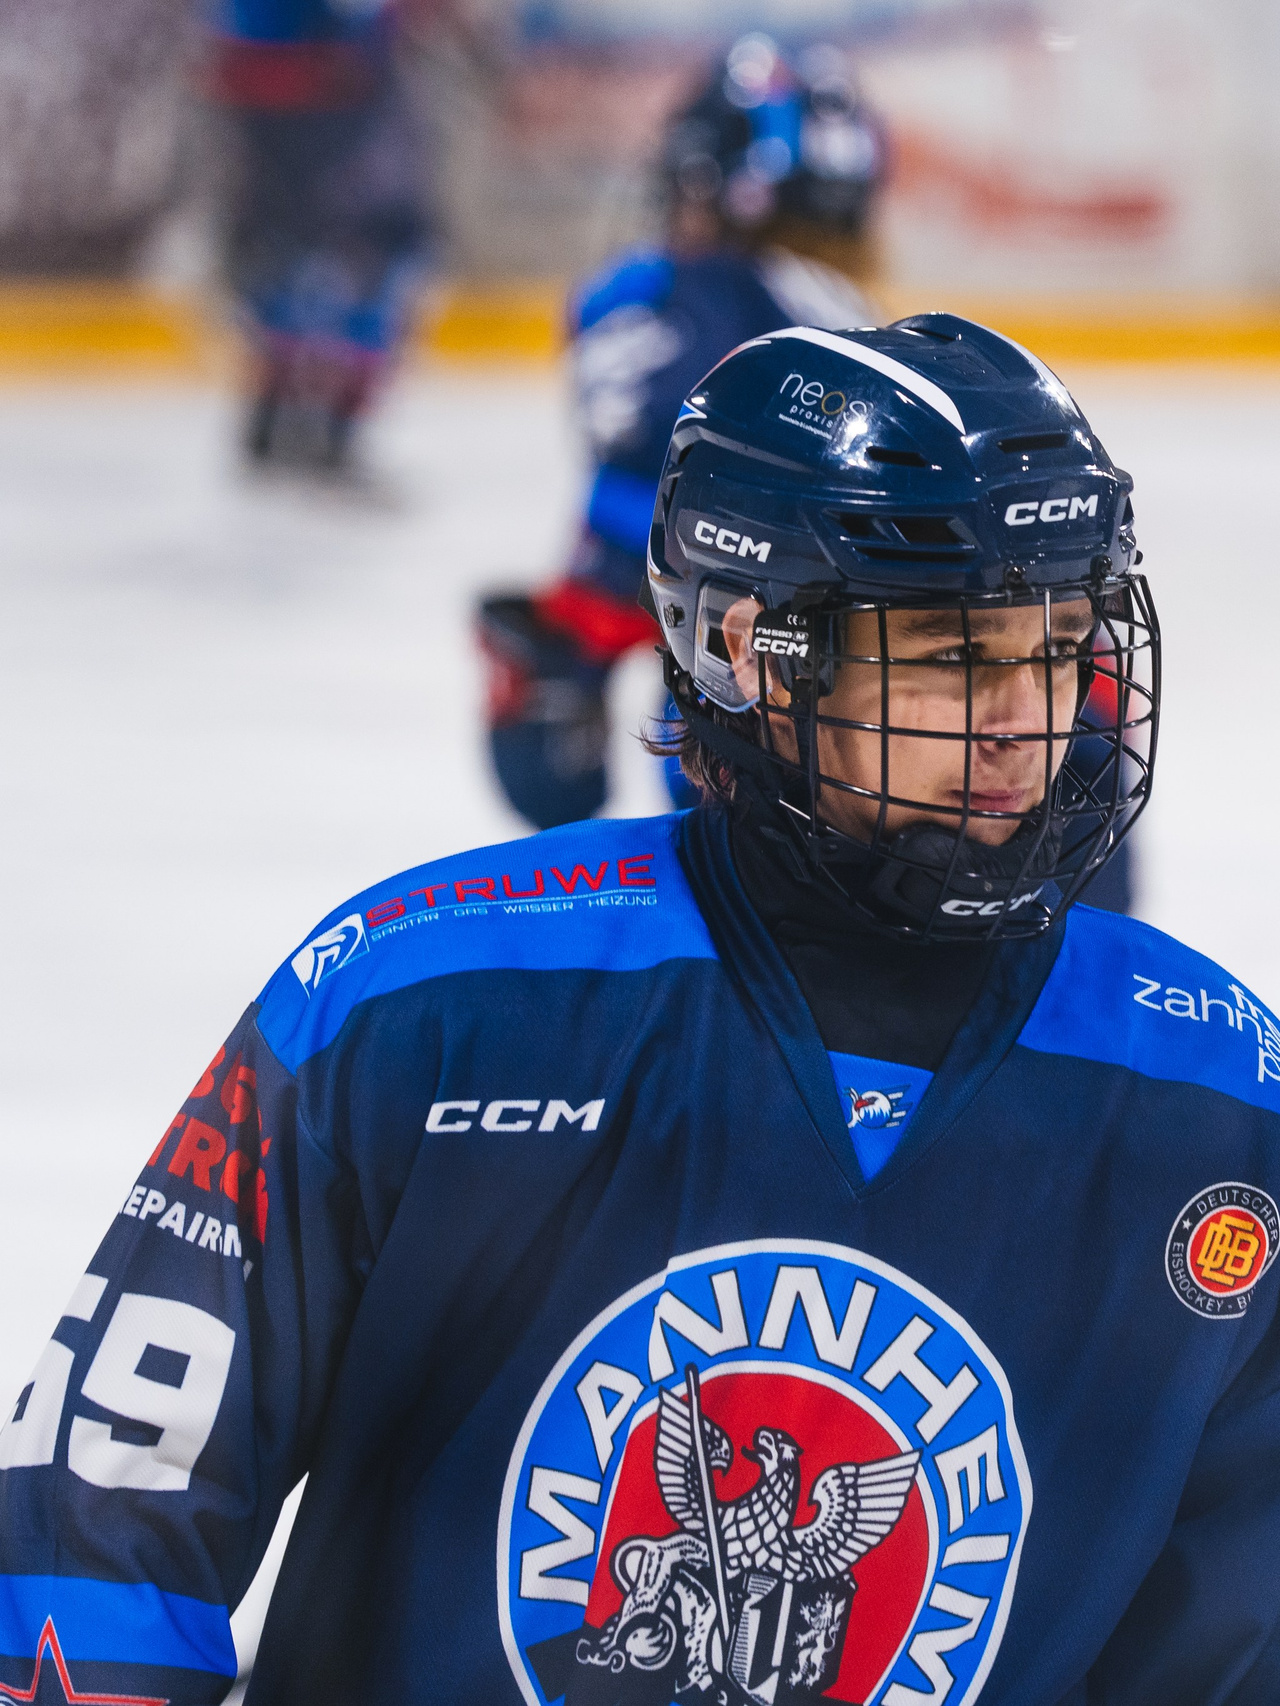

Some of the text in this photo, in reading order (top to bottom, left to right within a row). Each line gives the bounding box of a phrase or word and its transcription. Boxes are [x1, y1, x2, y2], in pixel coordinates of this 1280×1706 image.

[789, 404, 834, 429] praxis
[1004, 494, 1098, 526] CCM
[694, 520, 772, 563] CCM
[753, 637, 809, 658] CCM
[366, 853, 656, 928] STRUWE
[503, 900, 574, 915] WASSER
[425, 1098, 606, 1132] CCM
[1196, 1189, 1278, 1242] DEUTSCHER
[519, 1265, 1011, 1706] MANNHEIM
